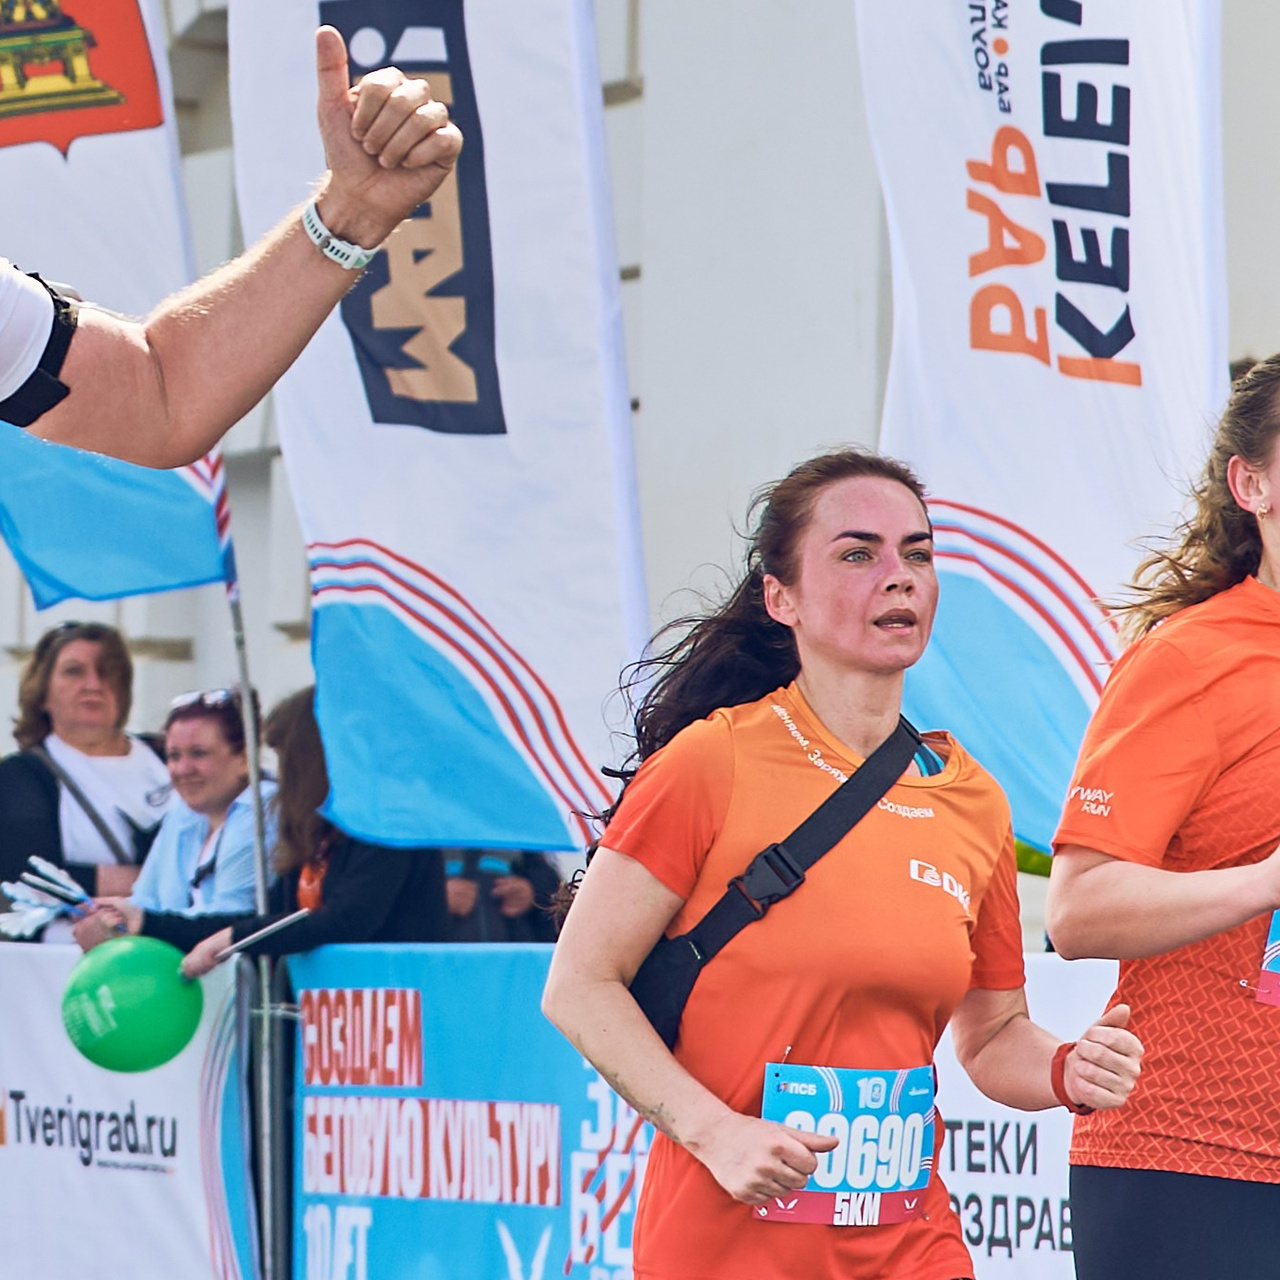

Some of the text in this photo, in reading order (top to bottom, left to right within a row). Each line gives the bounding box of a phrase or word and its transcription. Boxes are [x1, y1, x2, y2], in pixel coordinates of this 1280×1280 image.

[301, 988, 423, 1087] СОЗДАЕМ
[8, 1089, 178, 1167] Tverigrad.ru
[788, 1081, 818, 1097] ПСБ
[429, 1100, 561, 1207] КУЛЬТУРУ
